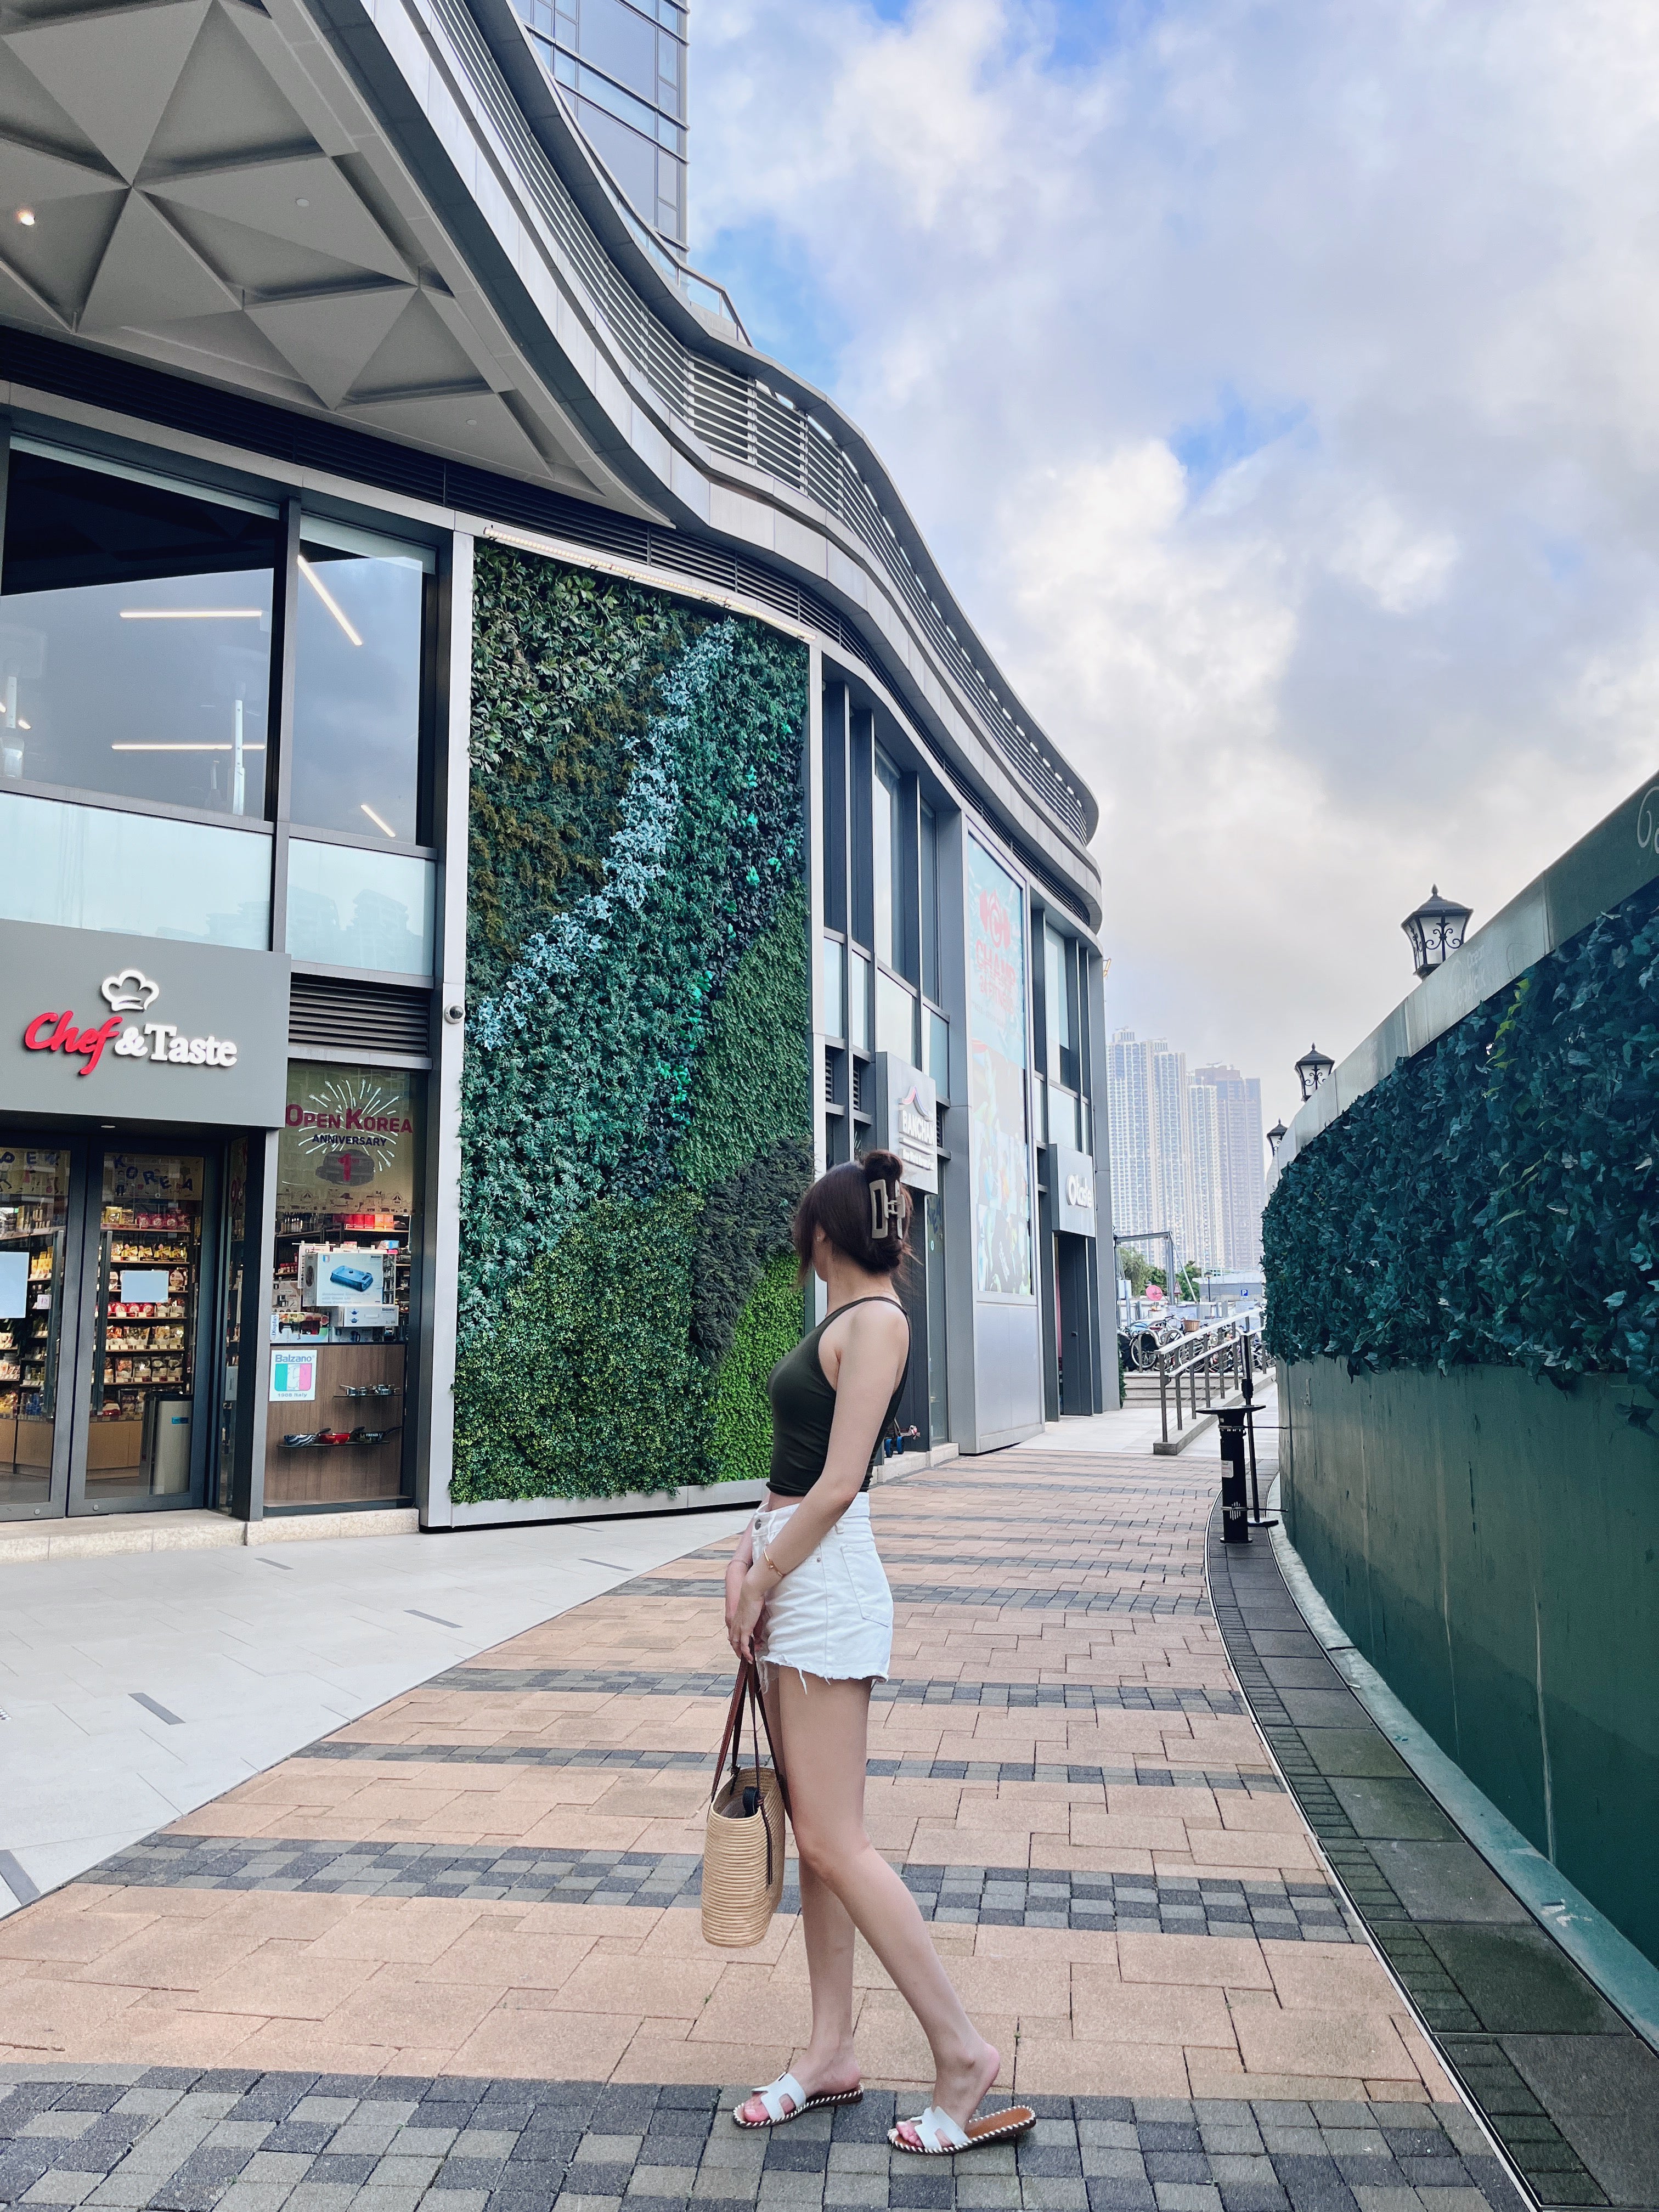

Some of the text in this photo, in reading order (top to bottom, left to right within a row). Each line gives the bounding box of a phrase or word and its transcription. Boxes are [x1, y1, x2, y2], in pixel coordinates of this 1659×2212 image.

[25, 1011, 123, 1075] Chef
[145, 1024, 238, 1067] Taste
[285, 1104, 413, 1133] OPEN KOREA
[900, 1109, 934, 1146] BANCHAN
[312, 1134, 387, 1147] ANNIVERSARY
[275, 1354, 312, 1362] Balzano
